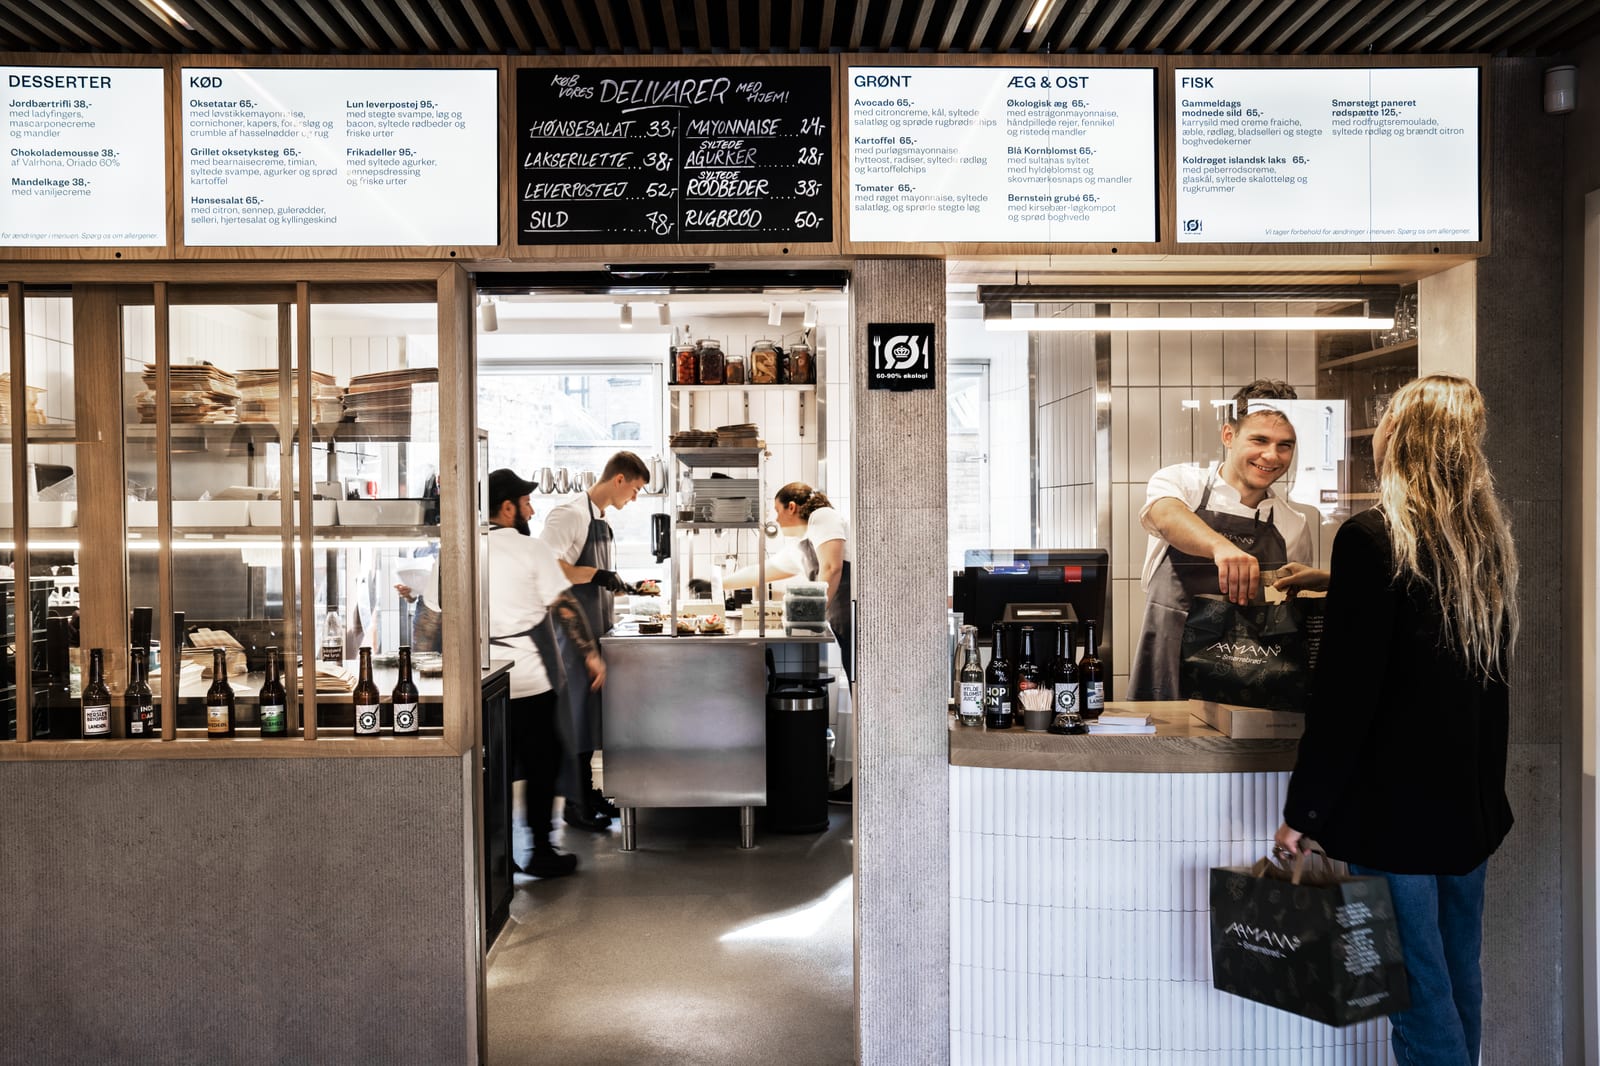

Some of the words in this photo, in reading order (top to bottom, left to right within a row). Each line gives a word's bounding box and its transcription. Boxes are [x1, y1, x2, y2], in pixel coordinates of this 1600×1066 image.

[9, 75, 111, 89] DESSERTER
[190, 77, 223, 88] KØD
[551, 74, 580, 87] KØB
[854, 76, 912, 88] GRØNT
[1007, 76, 1036, 88] ÆG
[1040, 76, 1052, 88] &
[1055, 77, 1089, 88] OST
[1182, 77, 1214, 88] FISK
[600, 77, 731, 104] DELIVARER
[736, 81, 763, 93] MED
[558, 87, 594, 99] VORES
[747, 91, 789, 103] HJEM!
[9, 100, 72, 108] Jordbærtrifli
[73, 100, 92, 110] 38,-
[189, 100, 238, 108] Oksetatar
[239, 100, 258, 109] 65,-
[346, 100, 364, 108] Lun
[366, 100, 418, 110] leverpostej
[419, 101, 438, 109] 95,-
[896, 99, 915, 108] 65,-
[1006, 100, 1052, 109] Økologisk
[1053, 100, 1068, 109] æg
[1071, 100, 1090, 108] 65,-
[1181, 99, 1242, 109] Gammeldags
[1331, 99, 1379, 108] Smørstegt
[1381, 99, 1416, 108] paneret
[9, 110, 30, 118] med
[346, 110, 367, 118] med
[367, 110, 396, 120] stegte
[435, 111, 450, 120] løg
[450, 111, 463, 120] og
[948, 109, 980, 118] syltede
[1246, 109, 1264, 117] 65,-
[1332, 109, 1379, 118] rødspætte
[1381, 109, 1402, 117] 125,-
[377, 120, 410, 129] syltede
[411, 120, 453, 128] rødbeder
[454, 121, 466, 129] og
[1006, 119, 1057, 128] håndpillede
[1181, 119, 1219, 128] karrysild
[1219, 118, 1240, 126] med
[1331, 118, 1351, 126] med
[530, 119, 636, 137] HØNSESALAT
[686, 119, 781, 136] MAYONNAISE
[1006, 129, 1019, 137] og
[1051, 128, 1087, 136] mandler
[1282, 128, 1295, 137] og
[1295, 128, 1323, 137] stegte
[1332, 128, 1363, 137] syltede
[1364, 128, 1392, 136] rødløg
[1393, 128, 1405, 136] og
[1406, 127, 1438, 135] brændt
[1439, 127, 1465, 135] citron
[9, 130, 22, 138] og
[699, 140, 744, 150] SYLTEDE
[899, 137, 918, 146] 65,-
[10, 148, 99, 158] Chokolademousse
[101, 150, 120, 159] 38,-
[190, 148, 220, 156] Grillet
[221, 148, 279, 158] oksetyksteg
[283, 148, 302, 157] 65,-
[346, 148, 397, 156] Frikadeller
[398, 149, 417, 157] 95,-
[1079, 147, 1097, 156] 65,-
[11, 158, 21, 166] af
[190, 158, 211, 166] med
[524, 152, 634, 167] LAKSERILETTE
[686, 148, 757, 167] AGURKER
[1182, 156, 1227, 165] Koldrøget
[1228, 156, 1266, 164] islandsk
[1292, 156, 1310, 164] 65,-
[698, 171, 740, 180] SYLTEDE
[11, 178, 70, 188] Mandelkage
[72, 179, 91, 188] 38,-
[524, 182, 628, 198] LEVERPOSTEJ
[855, 184, 894, 192] Tomater
[898, 184, 916, 193] 65,-
[1182, 184, 1236, 194] rugkrummer
[245, 197, 264, 206] 65,-
[1008, 194, 1052, 202] Bernstein
[1054, 194, 1081, 203] grubé
[1082, 194, 1100, 203] 65,-
[220, 216, 267, 225] hjertesalat
[268, 217, 280, 225] og
[530, 211, 568, 229] SILD
[685, 208, 762, 228] RUGBRØD
[986, 687, 1007, 697] HOP
